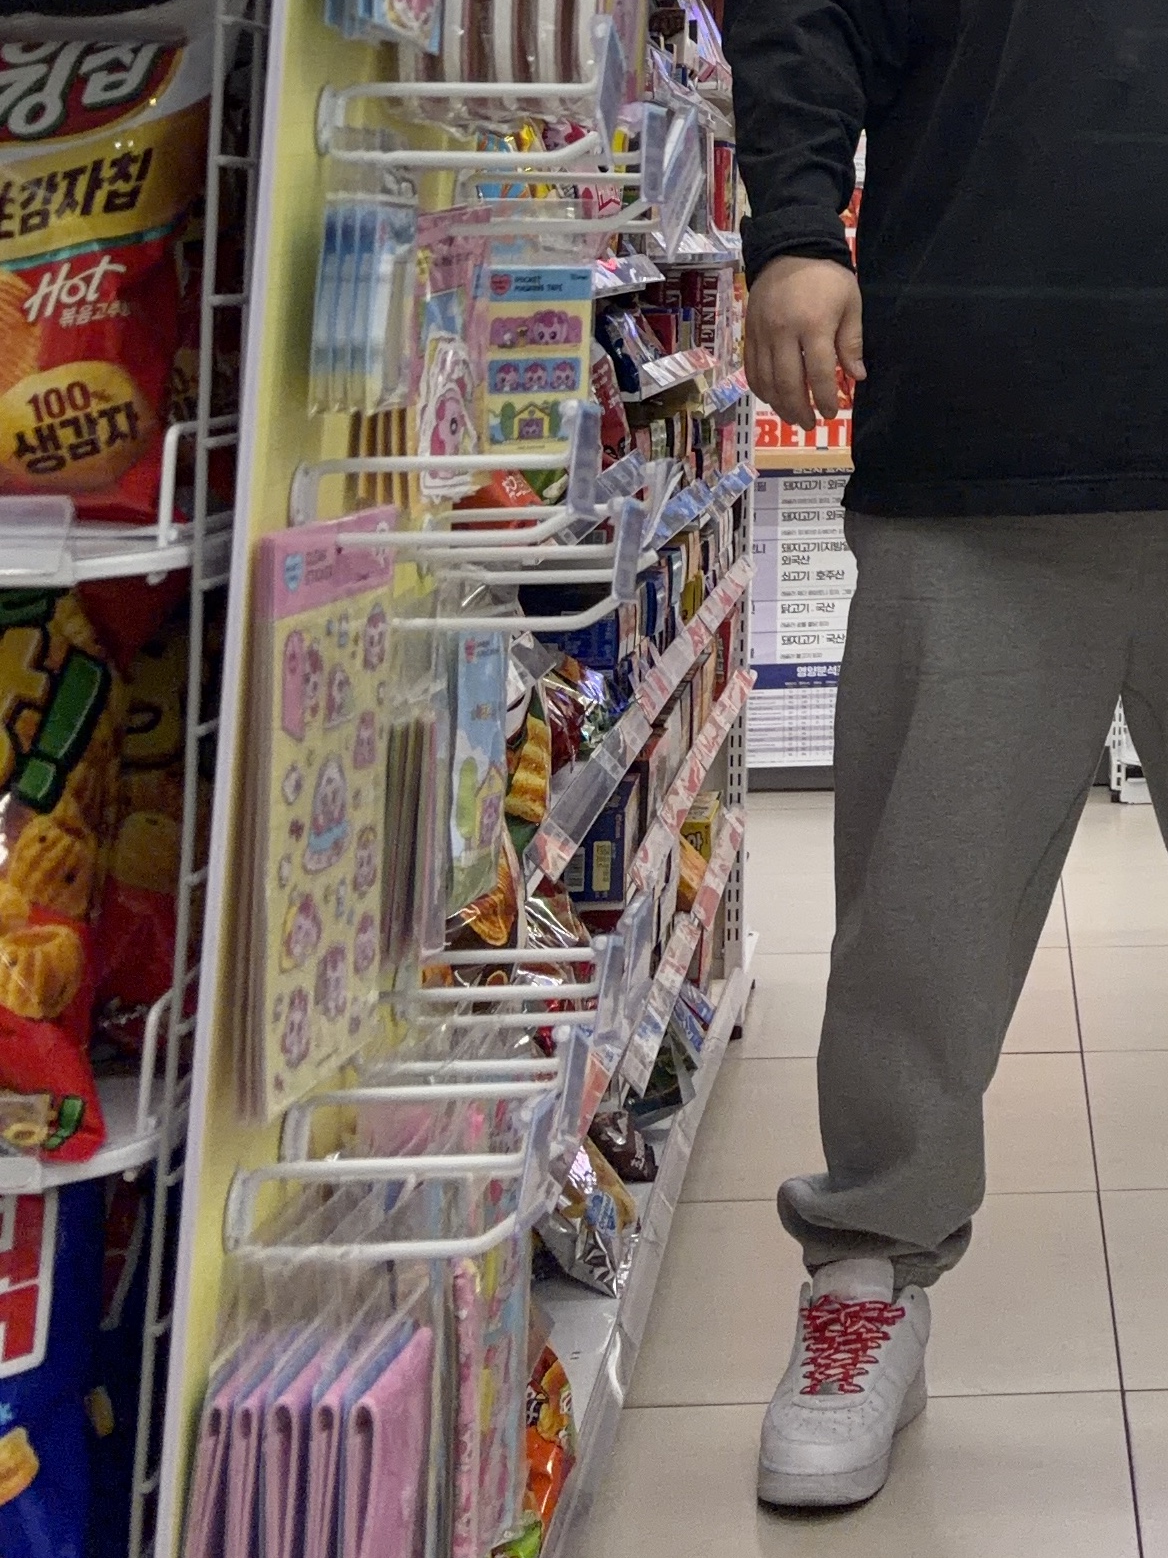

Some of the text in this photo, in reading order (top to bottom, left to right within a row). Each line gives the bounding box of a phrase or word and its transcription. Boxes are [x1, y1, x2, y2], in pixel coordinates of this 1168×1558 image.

[23, 254, 128, 324] Hot
[13, 399, 139, 476] 생감자
[782, 478, 847, 491] 돼지고기 외국
[781, 509, 845, 522] 돼지고기 외국
[781, 555, 811, 565] 외국산
[781, 569, 845, 582] 쇠고기 호주산
[815, 602, 836, 613] 국산
[781, 633, 845, 646] 돼지고기 국산
